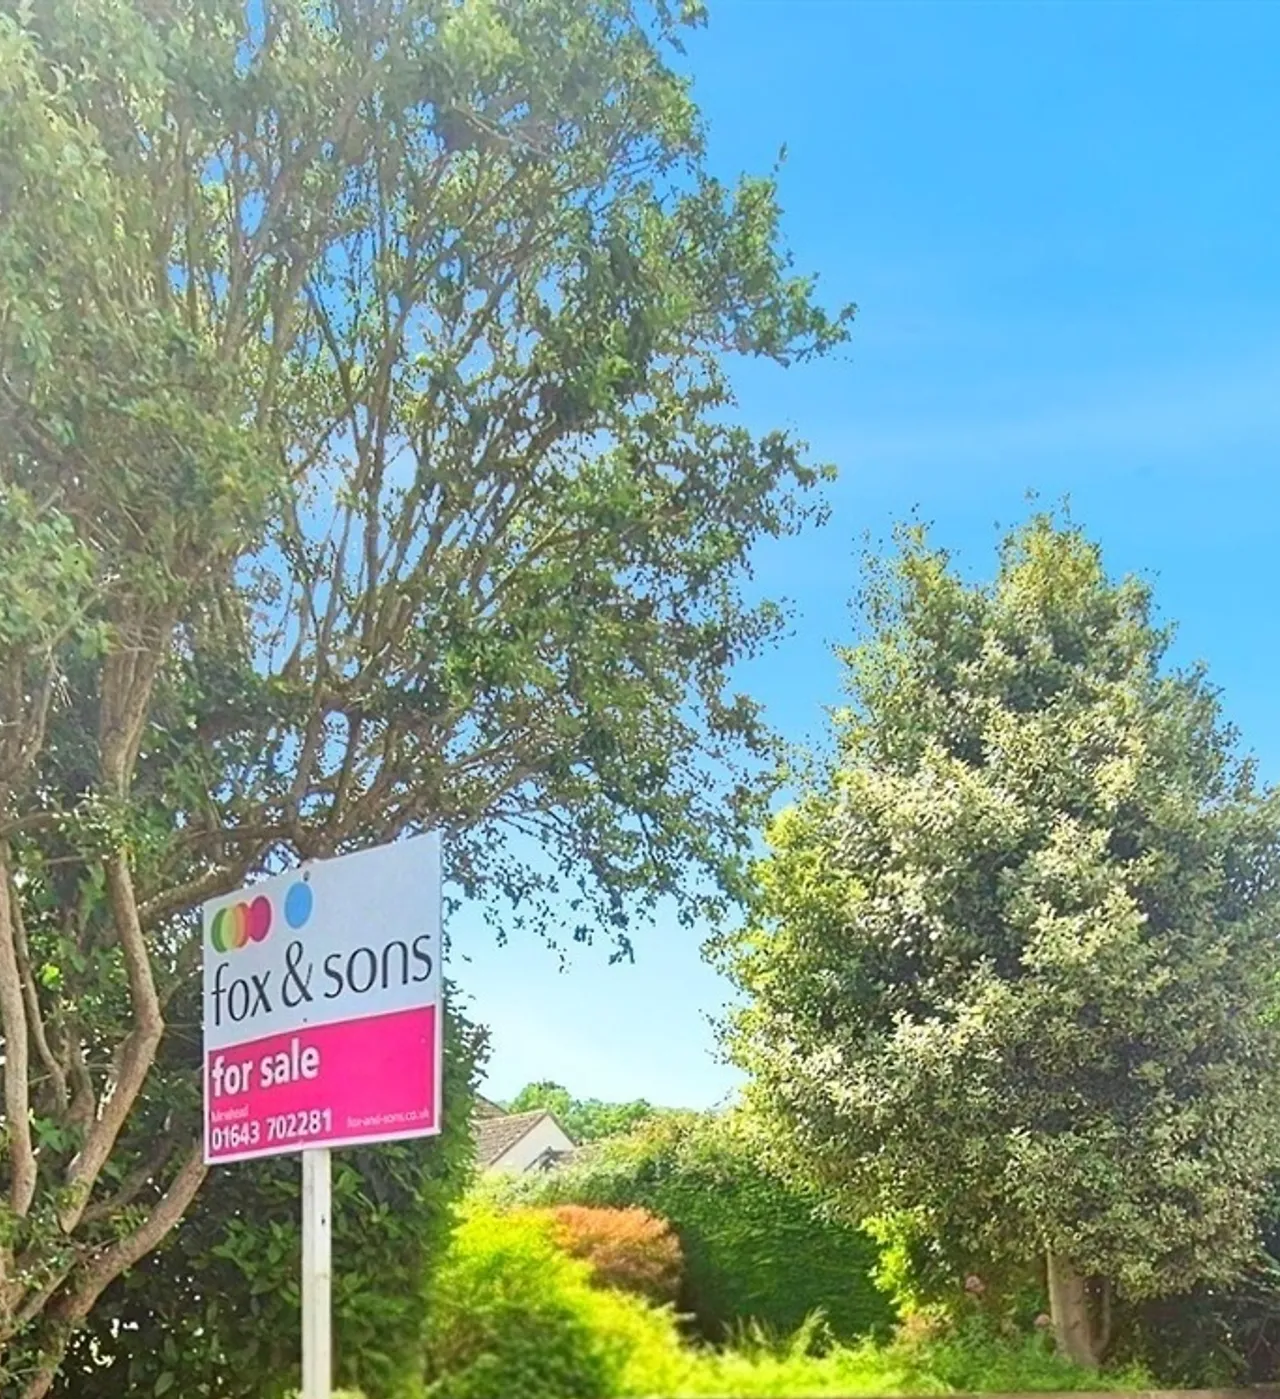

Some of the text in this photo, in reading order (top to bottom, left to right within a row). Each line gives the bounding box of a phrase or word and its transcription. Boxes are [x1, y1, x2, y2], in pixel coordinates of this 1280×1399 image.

[211, 934, 432, 1026] fox & sons
[211, 1038, 320, 1097] for sale
[212, 1120, 260, 1150] 01643
[267, 1107, 332, 1141] 702281
